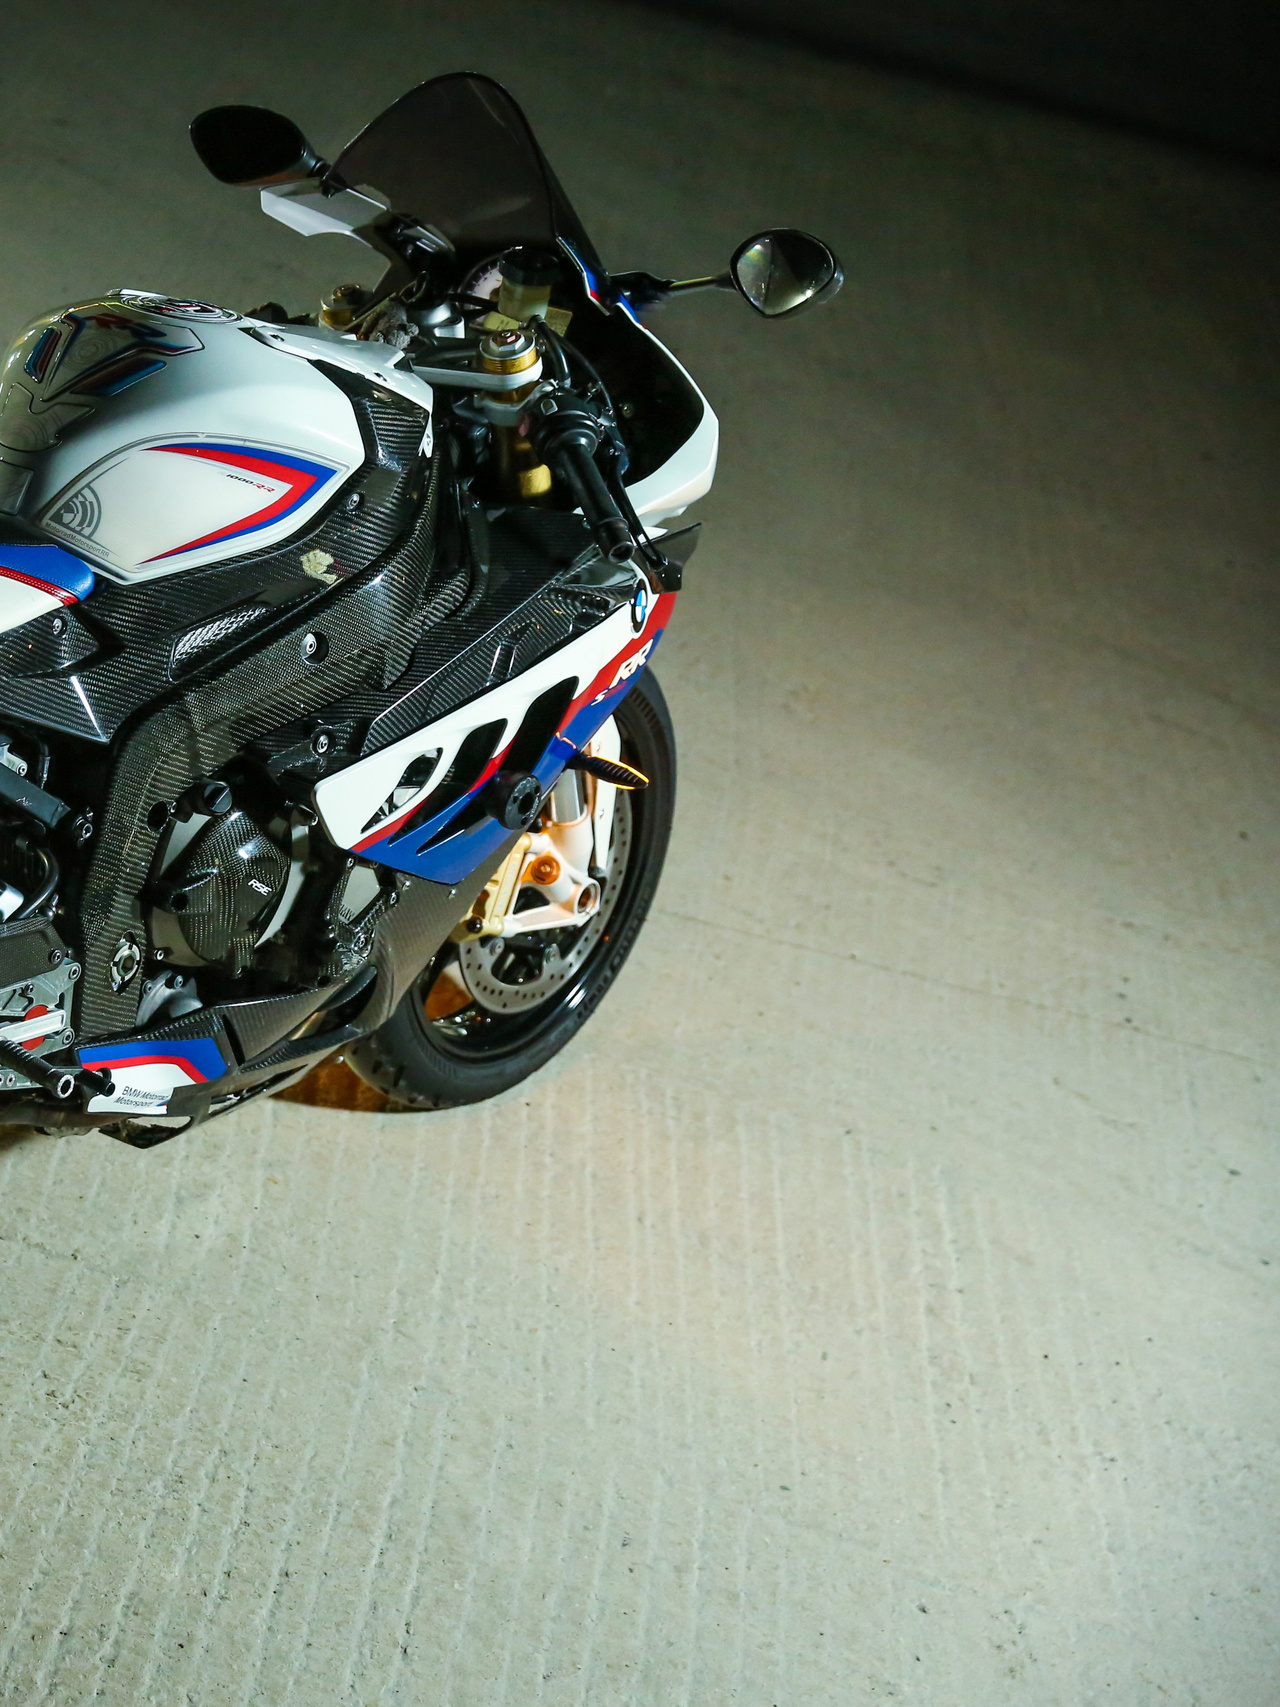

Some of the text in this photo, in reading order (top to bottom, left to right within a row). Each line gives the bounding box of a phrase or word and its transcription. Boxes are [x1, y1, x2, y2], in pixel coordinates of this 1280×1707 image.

[608, 638, 654, 689] RR
[247, 878, 273, 896] RSE
[121, 1085, 144, 1098] BMW
[113, 1096, 154, 1108] Motorsport
